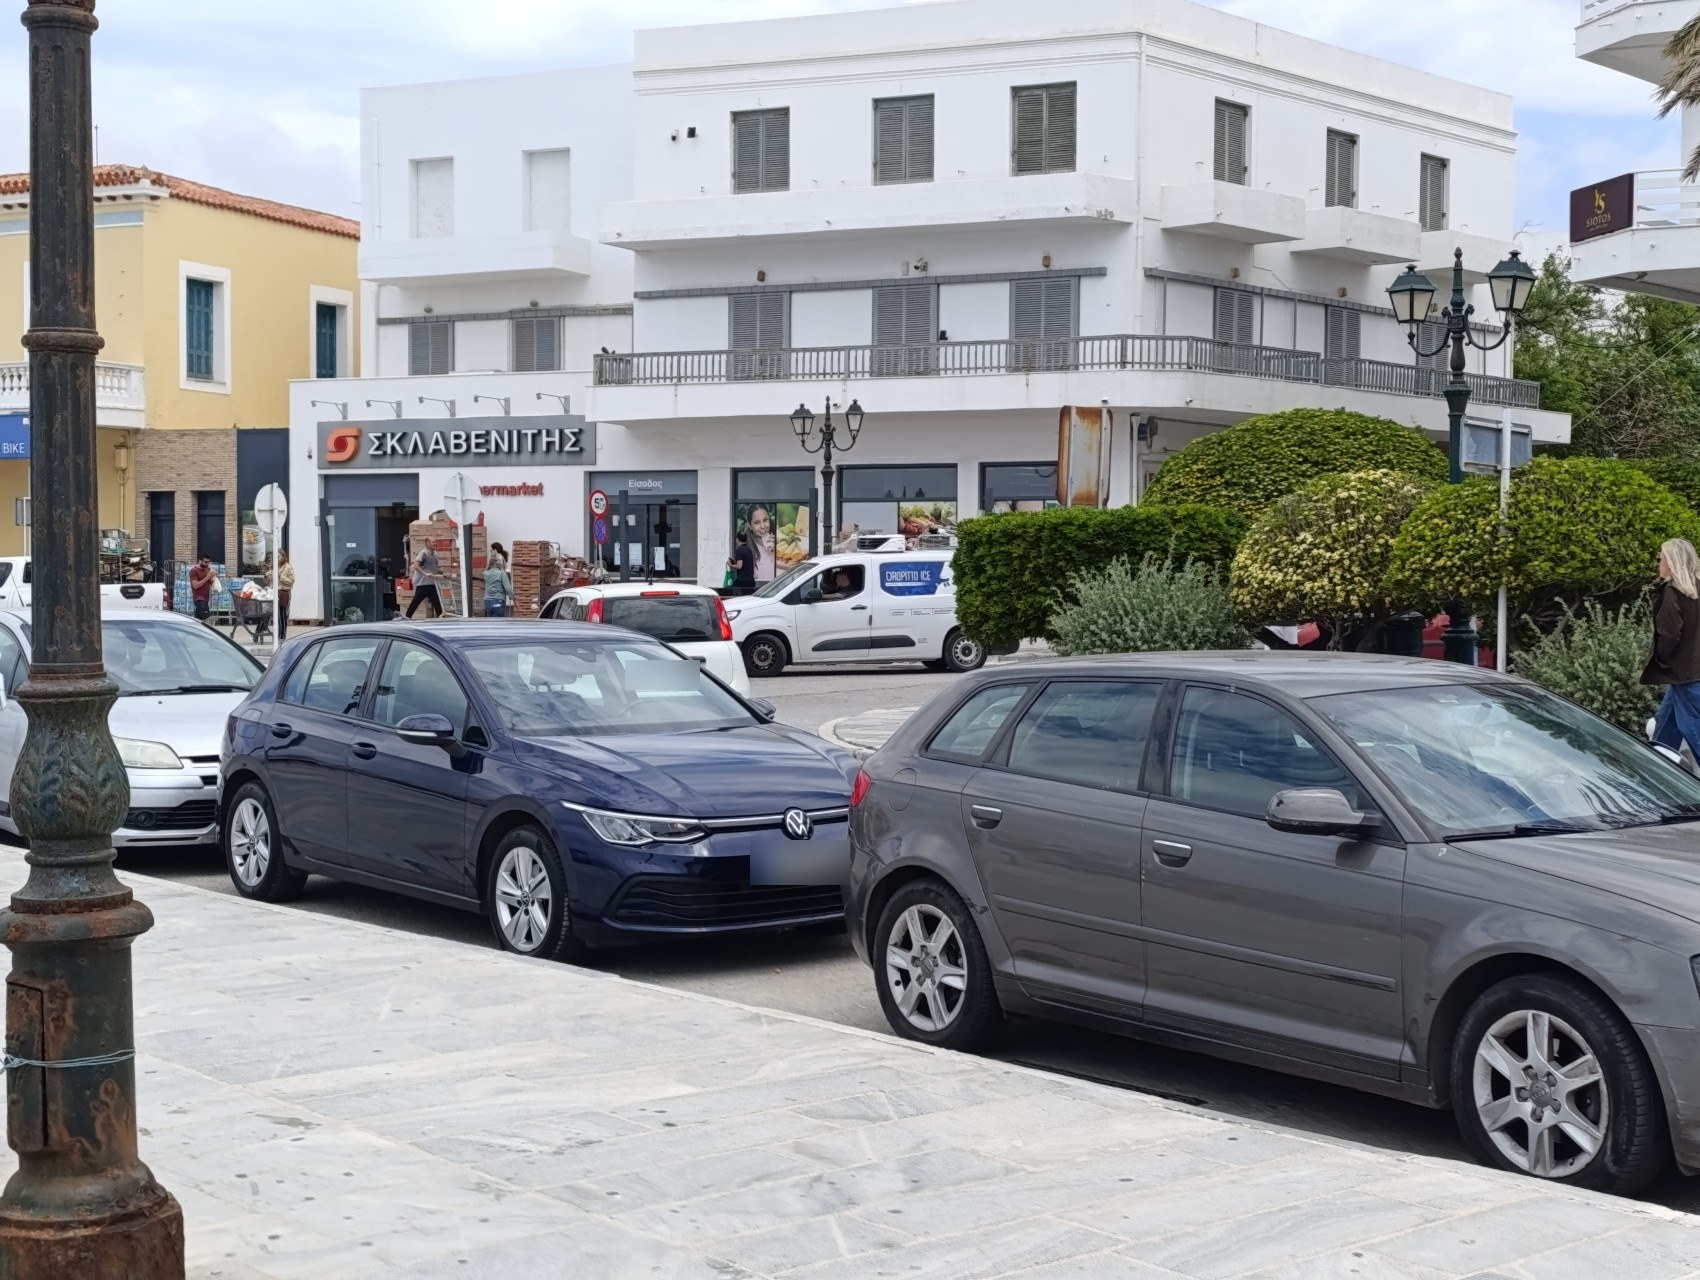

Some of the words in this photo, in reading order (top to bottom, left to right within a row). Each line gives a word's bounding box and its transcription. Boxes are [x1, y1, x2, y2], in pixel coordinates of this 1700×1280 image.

[1585, 212, 1611, 228] SIOTOS
[3, 442, 26, 454] BIKE
[367, 427, 583, 456] ΣΚΛΑΒΕΝΙΤΗΣ
[479, 482, 544, 496] ermarket
[628, 479, 663, 489] Είσοδος
[920, 570, 931, 581] ICE
